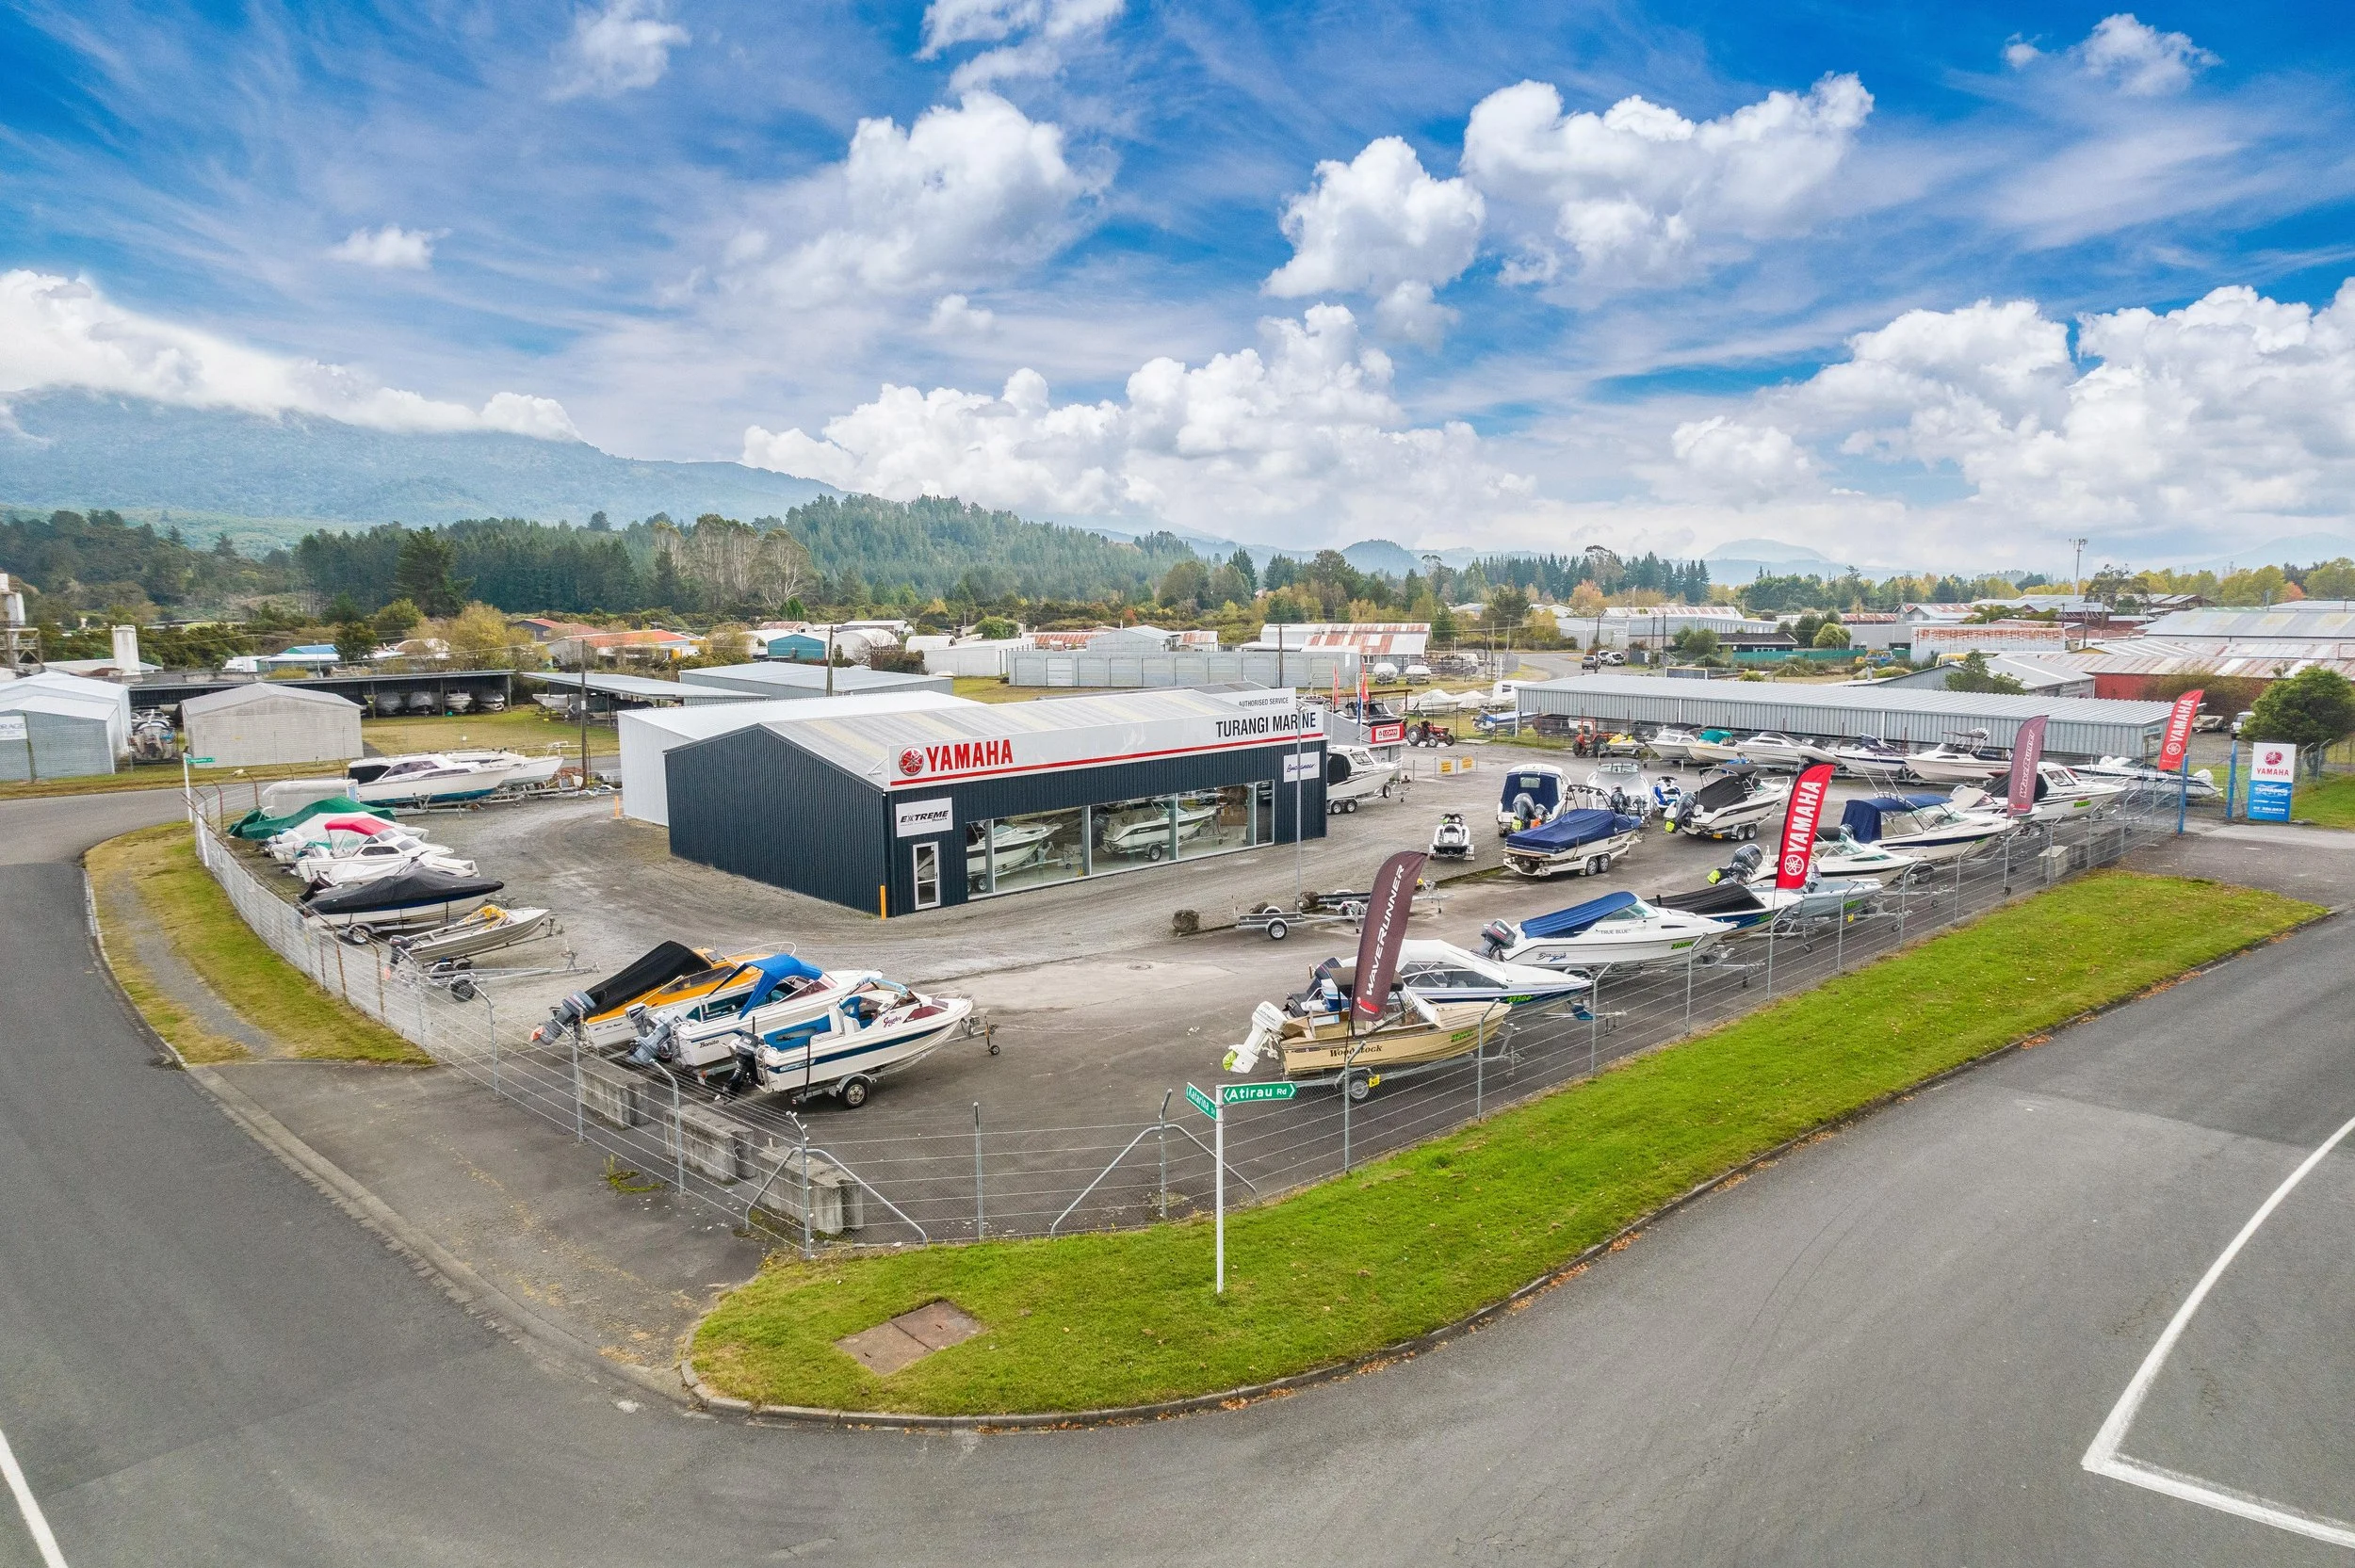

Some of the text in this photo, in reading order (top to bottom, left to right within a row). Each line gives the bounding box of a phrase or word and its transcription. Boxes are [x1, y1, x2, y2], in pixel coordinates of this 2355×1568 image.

[1270, 697, 1289, 705] SERVICE
[1216, 712, 1316, 737] TURANGI MARNE
[2169, 700, 2195, 742] YAMAHA
[925, 738, 1014, 772] YAMAHA
[2256, 768, 2290, 776] YAMAHA
[900, 810, 950, 823] EXTREME
[1787, 781, 1823, 852] YAMAHA
[1366, 864, 1405, 996] WAVERUNNER
[699, 1040, 720, 1049] Bonito
[1329, 1044, 1383, 1057] Woodtock
[1188, 1086, 1210, 1111] Katarina
[1228, 1088, 1273, 1101] Atirau
